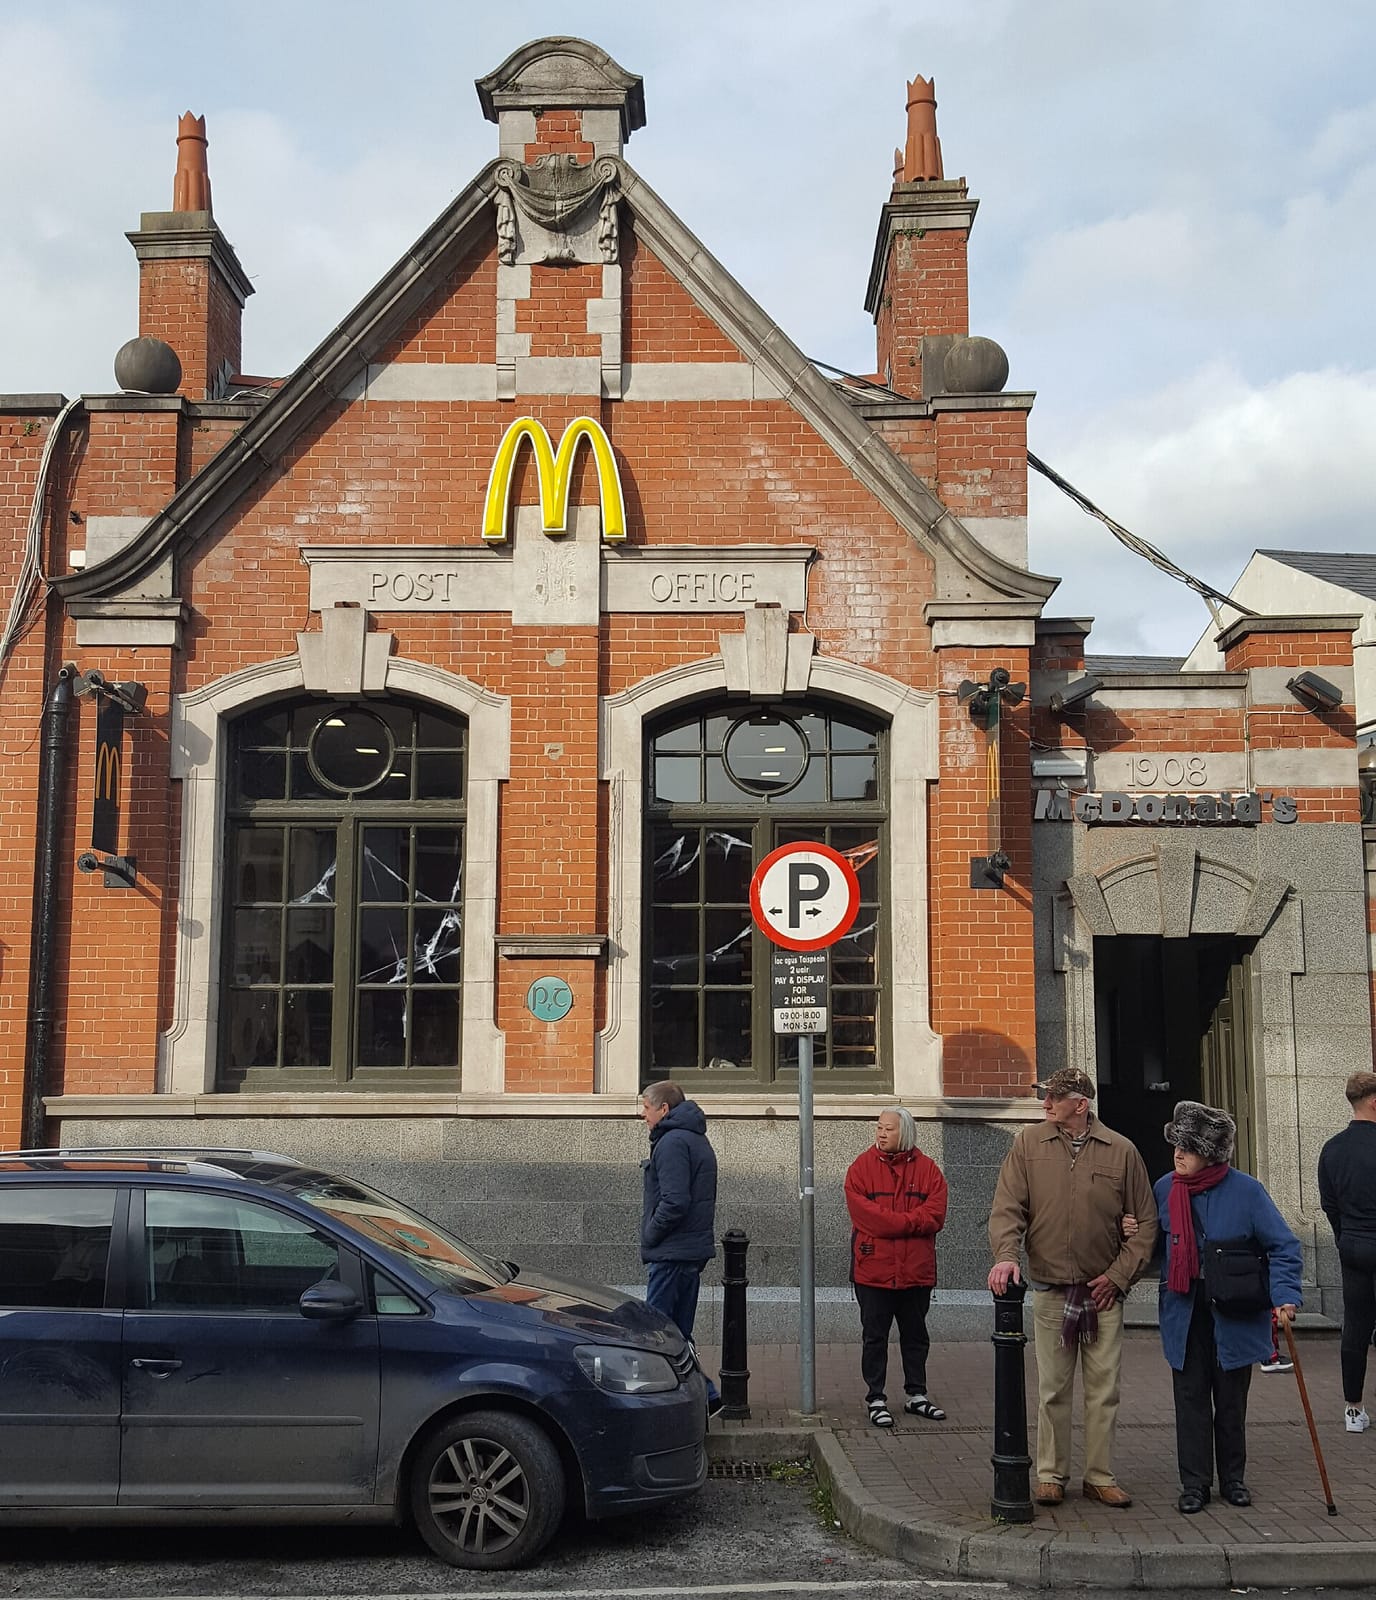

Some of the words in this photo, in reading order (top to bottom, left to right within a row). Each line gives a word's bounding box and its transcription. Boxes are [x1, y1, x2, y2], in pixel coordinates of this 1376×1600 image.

[481, 415, 627, 542] M
[367, 572, 458, 602] POST
[650, 573, 758, 603] OFFICE
[1126, 757, 1207, 787] 1908
[1033, 789, 1298, 824] McDonald's
[788, 862, 830, 929] P
[774, 977, 787, 985] PAY
[789, 976, 795, 984] &
[796, 975, 825, 984] DISPLAY
[789, 966, 795, 974] 2
[783, 996, 790, 1005] 2
[791, 995, 816, 1004] HOURS
[792, 986, 807, 994] FOR
